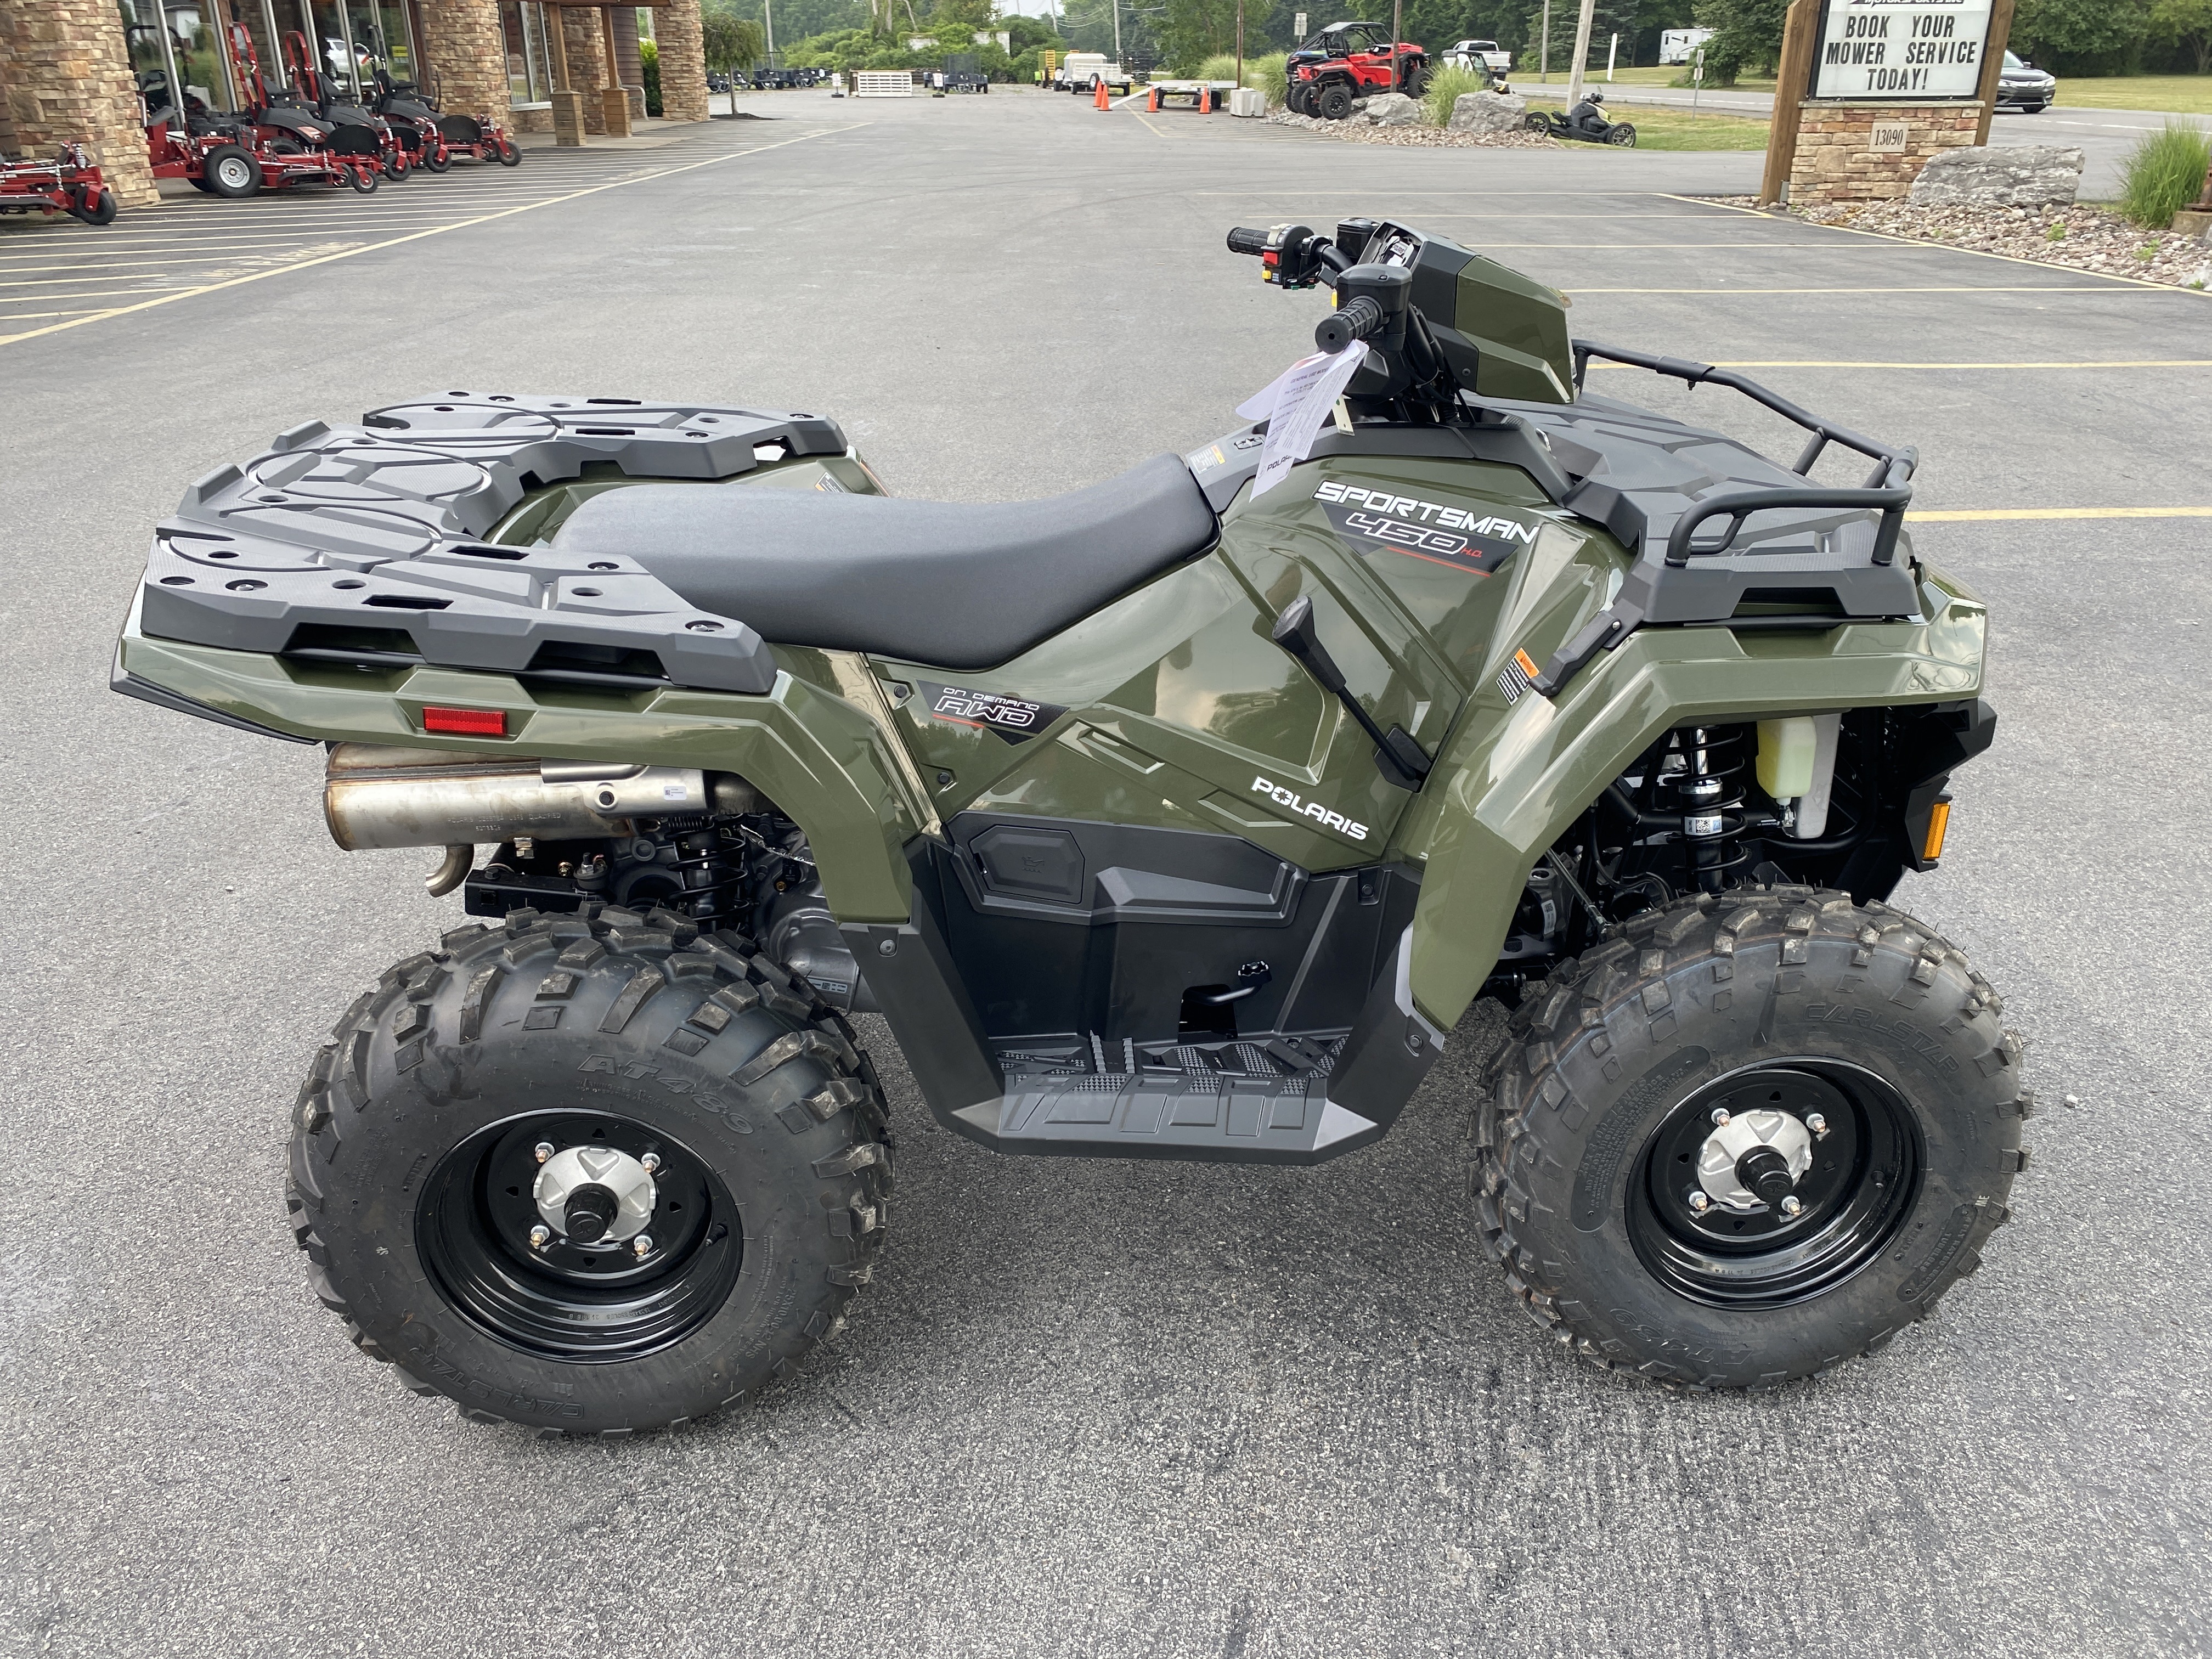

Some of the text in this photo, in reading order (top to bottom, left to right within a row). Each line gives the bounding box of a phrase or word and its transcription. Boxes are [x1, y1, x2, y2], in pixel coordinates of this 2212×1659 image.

[1846, 15, 1955, 38] BOOK YOUR
[1826, 41, 1977, 64] MOWER SERVICE
[1867, 69, 1928, 90] TODAY!
[1875, 129, 1903, 145] 13090
[1313, 481, 1539, 544] SPORTSMAN
[1346, 512, 1468, 555] 450
[934, 696, 1035, 726] AWD
[943, 687, 1040, 710] ON DEMAND
[1251, 776, 1369, 840] POLARIS
[1803, 1002, 1960, 1074] CARLSTAR
[577, 1054, 754, 1134] AT489
[743, 1339, 767, 1360] NHS
[1610, 1308, 1754, 1365] AT489
[409, 1344, 584, 1419] CARLSTAR
